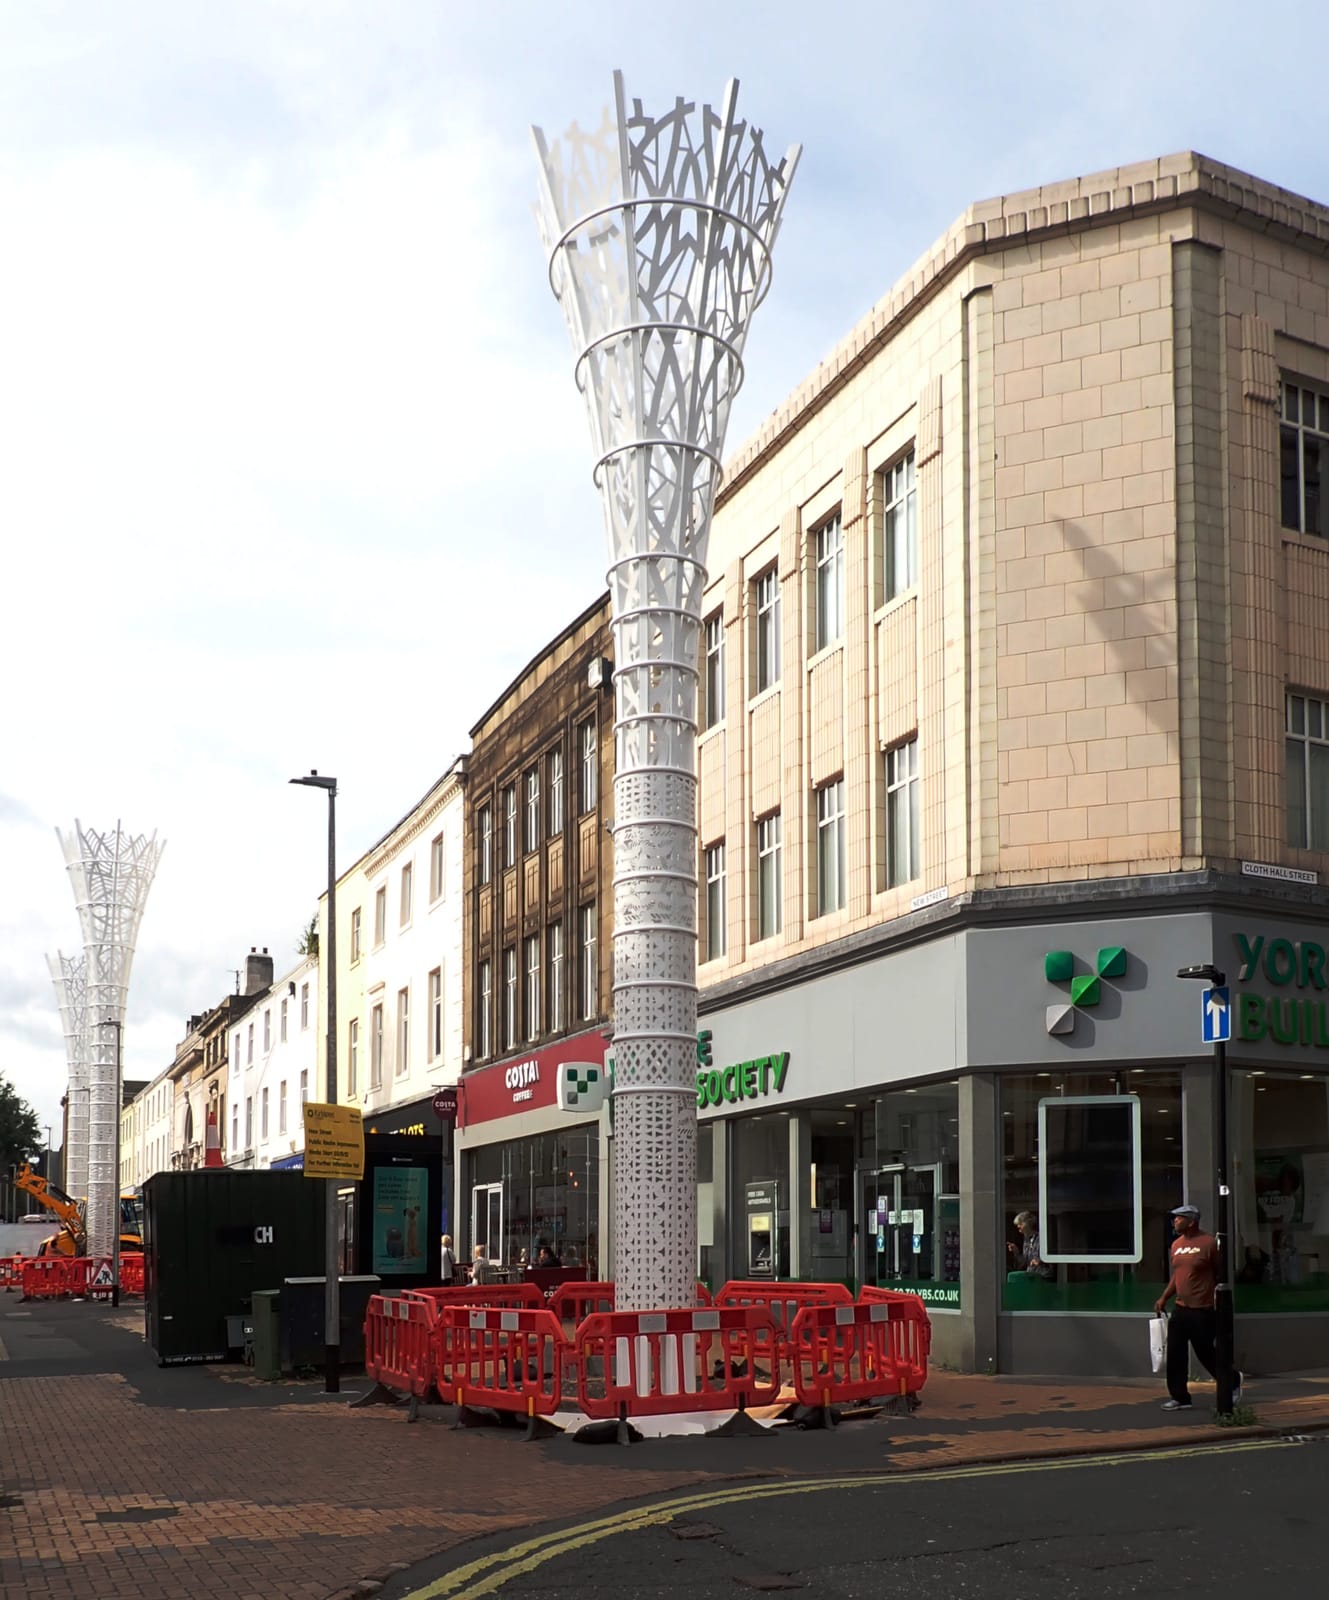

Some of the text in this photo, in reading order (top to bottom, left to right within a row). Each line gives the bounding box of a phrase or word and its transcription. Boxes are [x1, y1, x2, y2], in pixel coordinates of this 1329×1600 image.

[1244, 863, 1315, 882] CLOTH HALL STREET
[926, 889, 947, 904] STREET
[1232, 933, 1329, 990] YOR
[505, 1060, 539, 1089] COSTA
[697, 1051, 790, 1108] SOCIETY
[434, 1101, 456, 1109] COSTA
[917, 1288, 959, 1302] YBS.CO.UK
